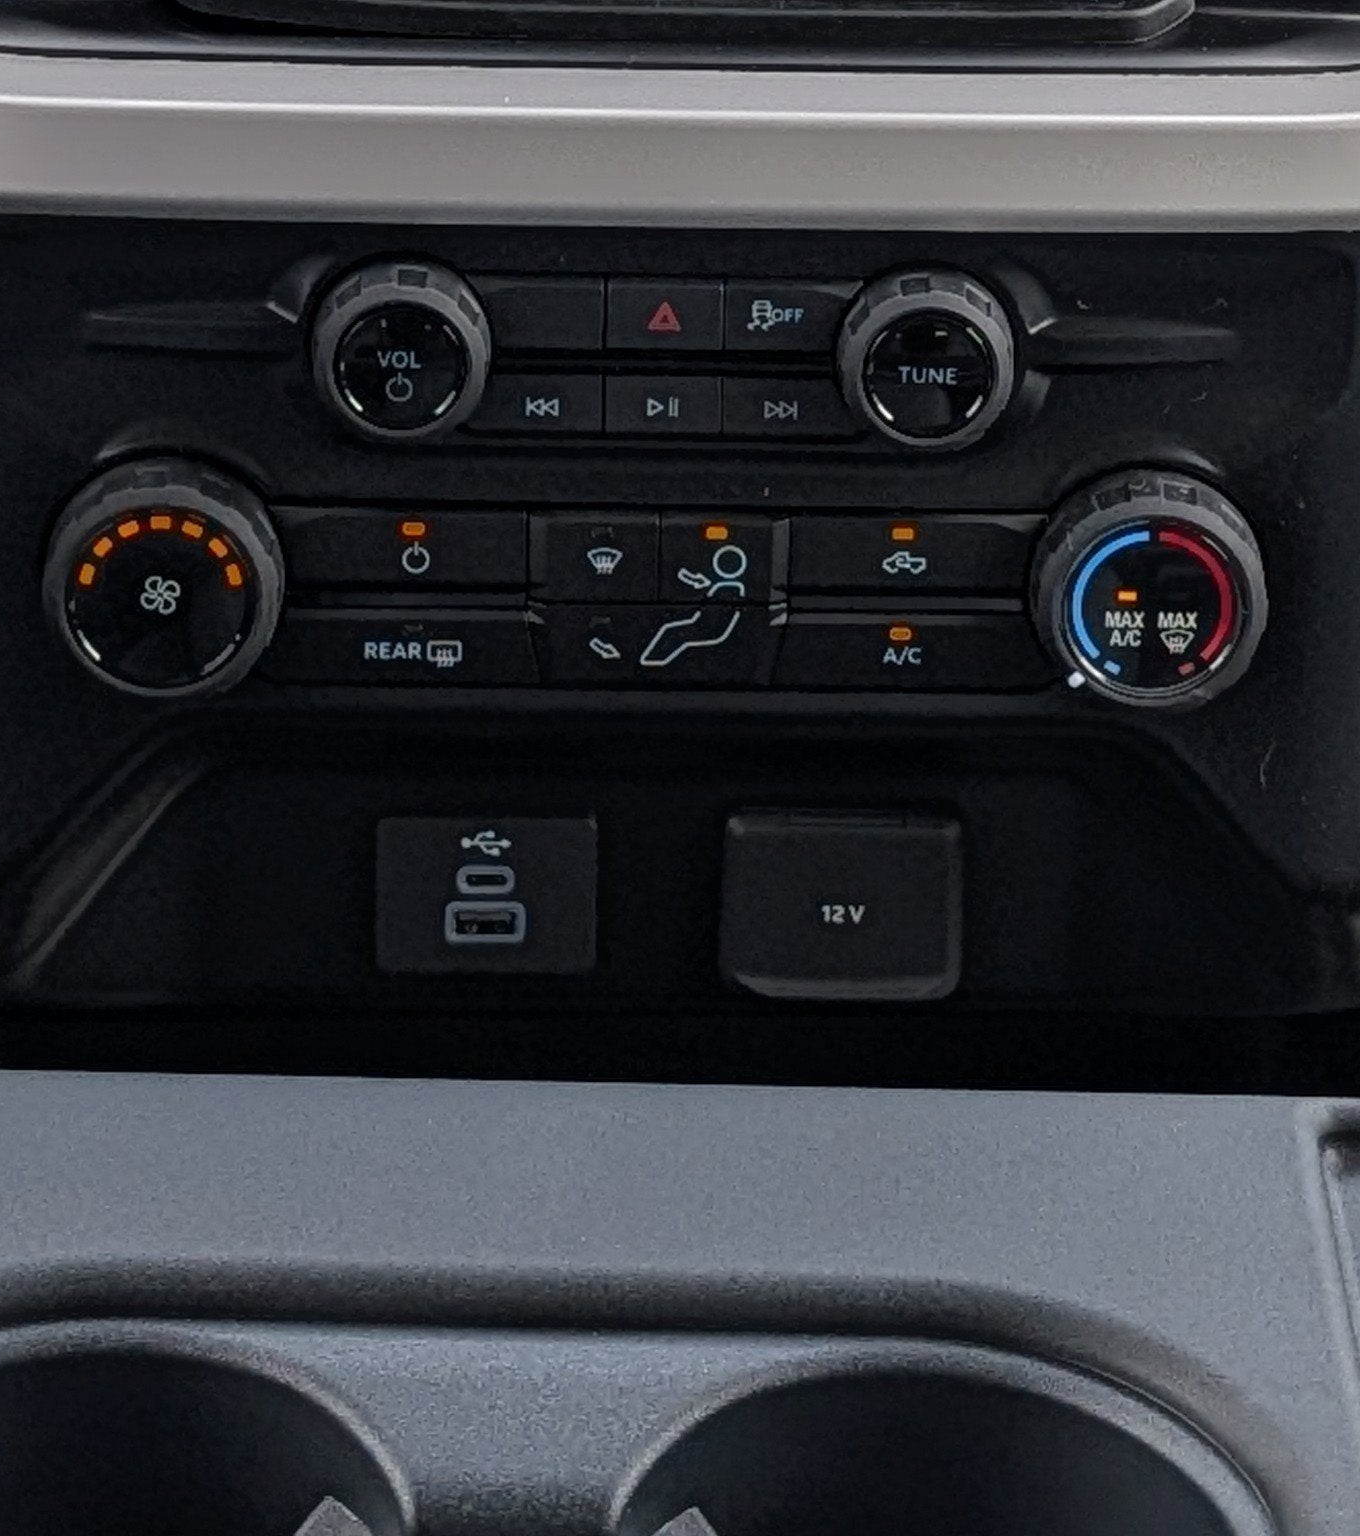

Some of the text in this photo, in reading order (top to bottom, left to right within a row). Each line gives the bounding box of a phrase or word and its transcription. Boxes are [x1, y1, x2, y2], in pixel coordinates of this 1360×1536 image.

[771, 308, 805, 326] OFF
[377, 350, 422, 370] VOL
[898, 366, 959, 386] TUNE
[1105, 611, 1145, 629] MAX
[1157, 611, 1198, 629] MAX
[1109, 629, 1142, 648] A/C
[364, 641, 422, 660] REAR
[883, 646, 922, 666] A/C
